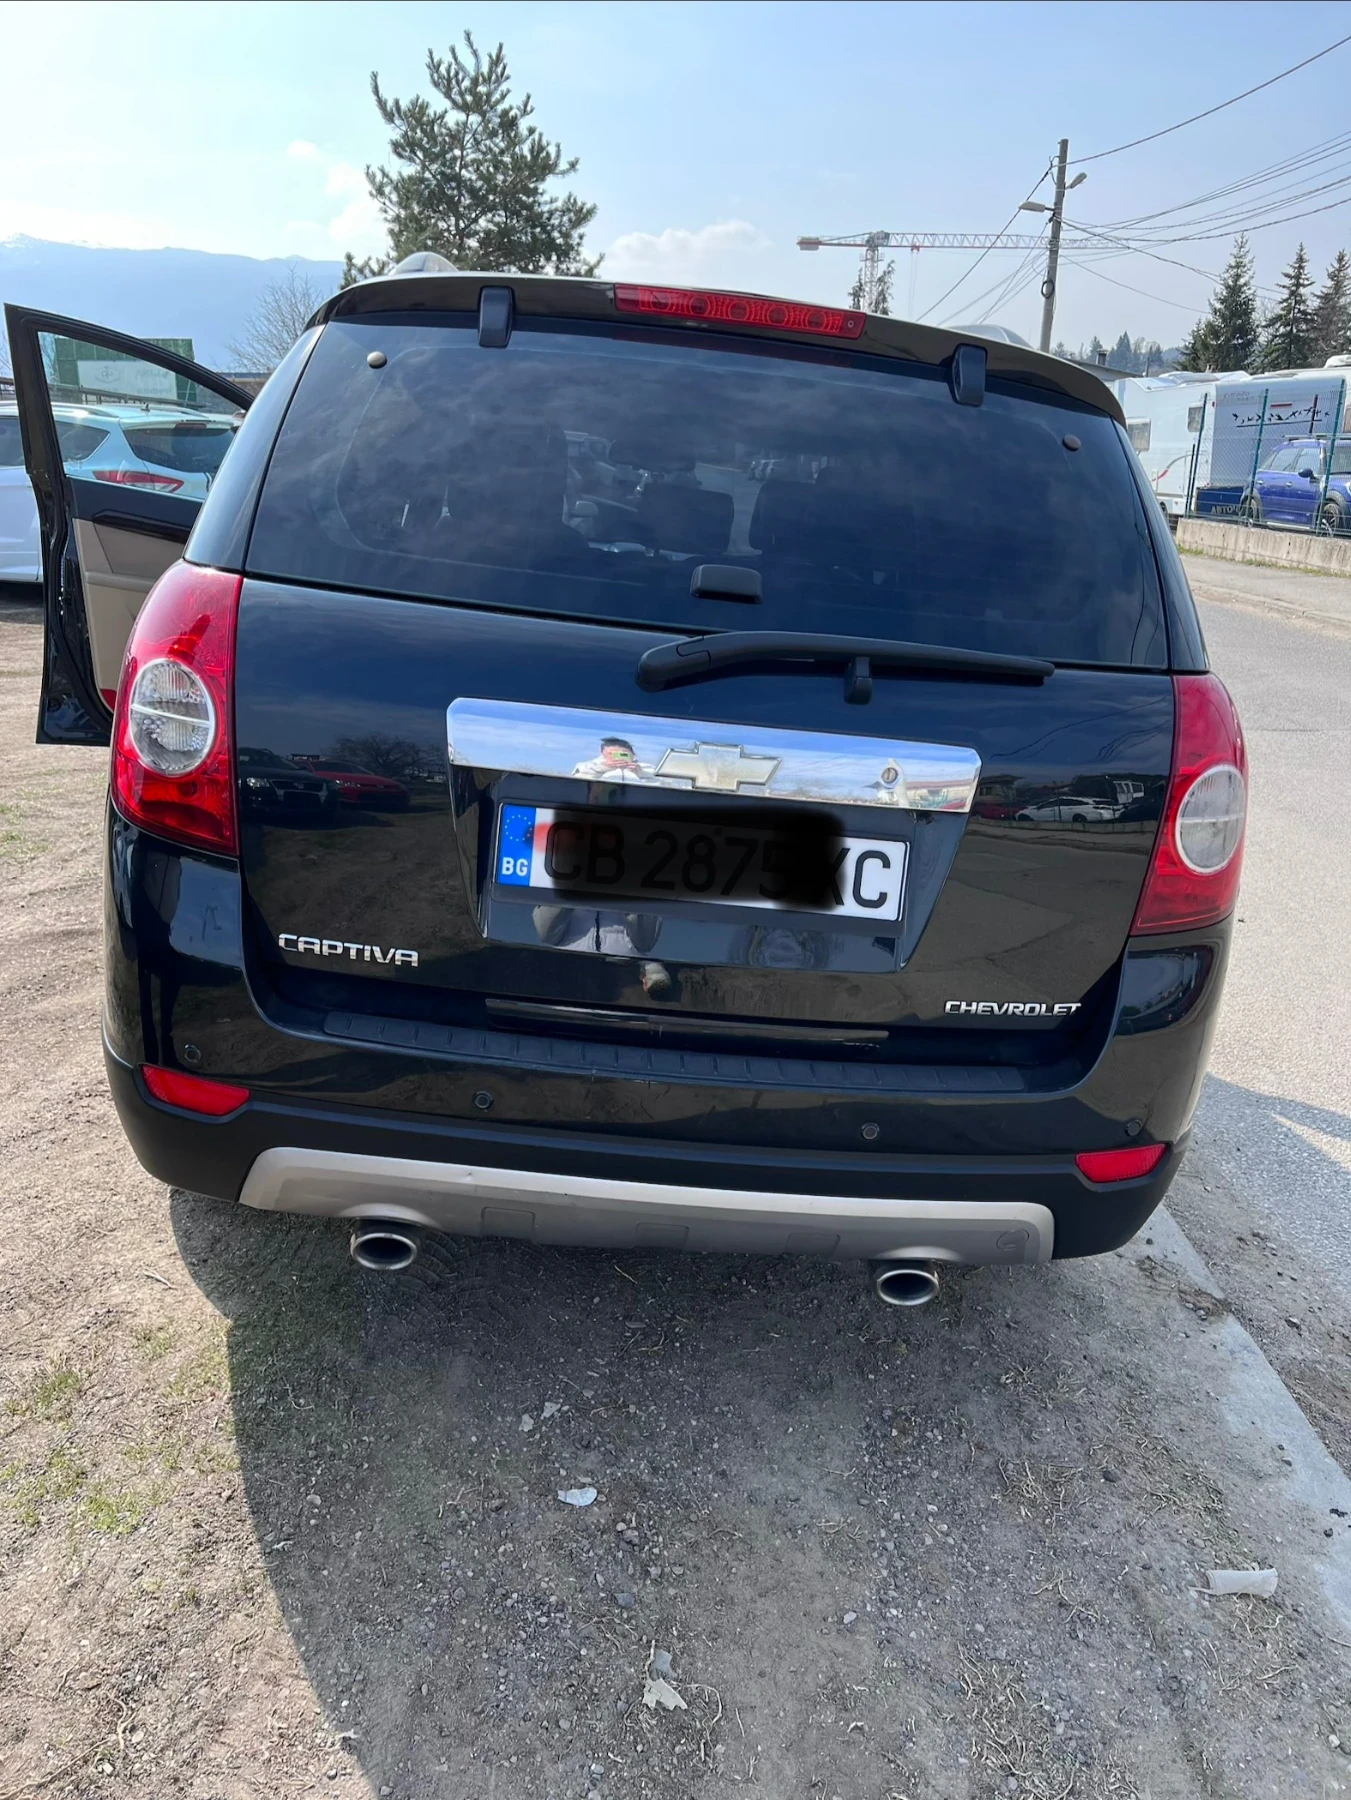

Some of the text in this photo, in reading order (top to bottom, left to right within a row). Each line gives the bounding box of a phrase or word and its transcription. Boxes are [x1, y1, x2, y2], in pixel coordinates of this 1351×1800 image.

[501, 857, 528, 877] BG
[279, 933, 418, 967] CAPTIVA
[944, 1000, 1082, 1016] CHEVROLET
